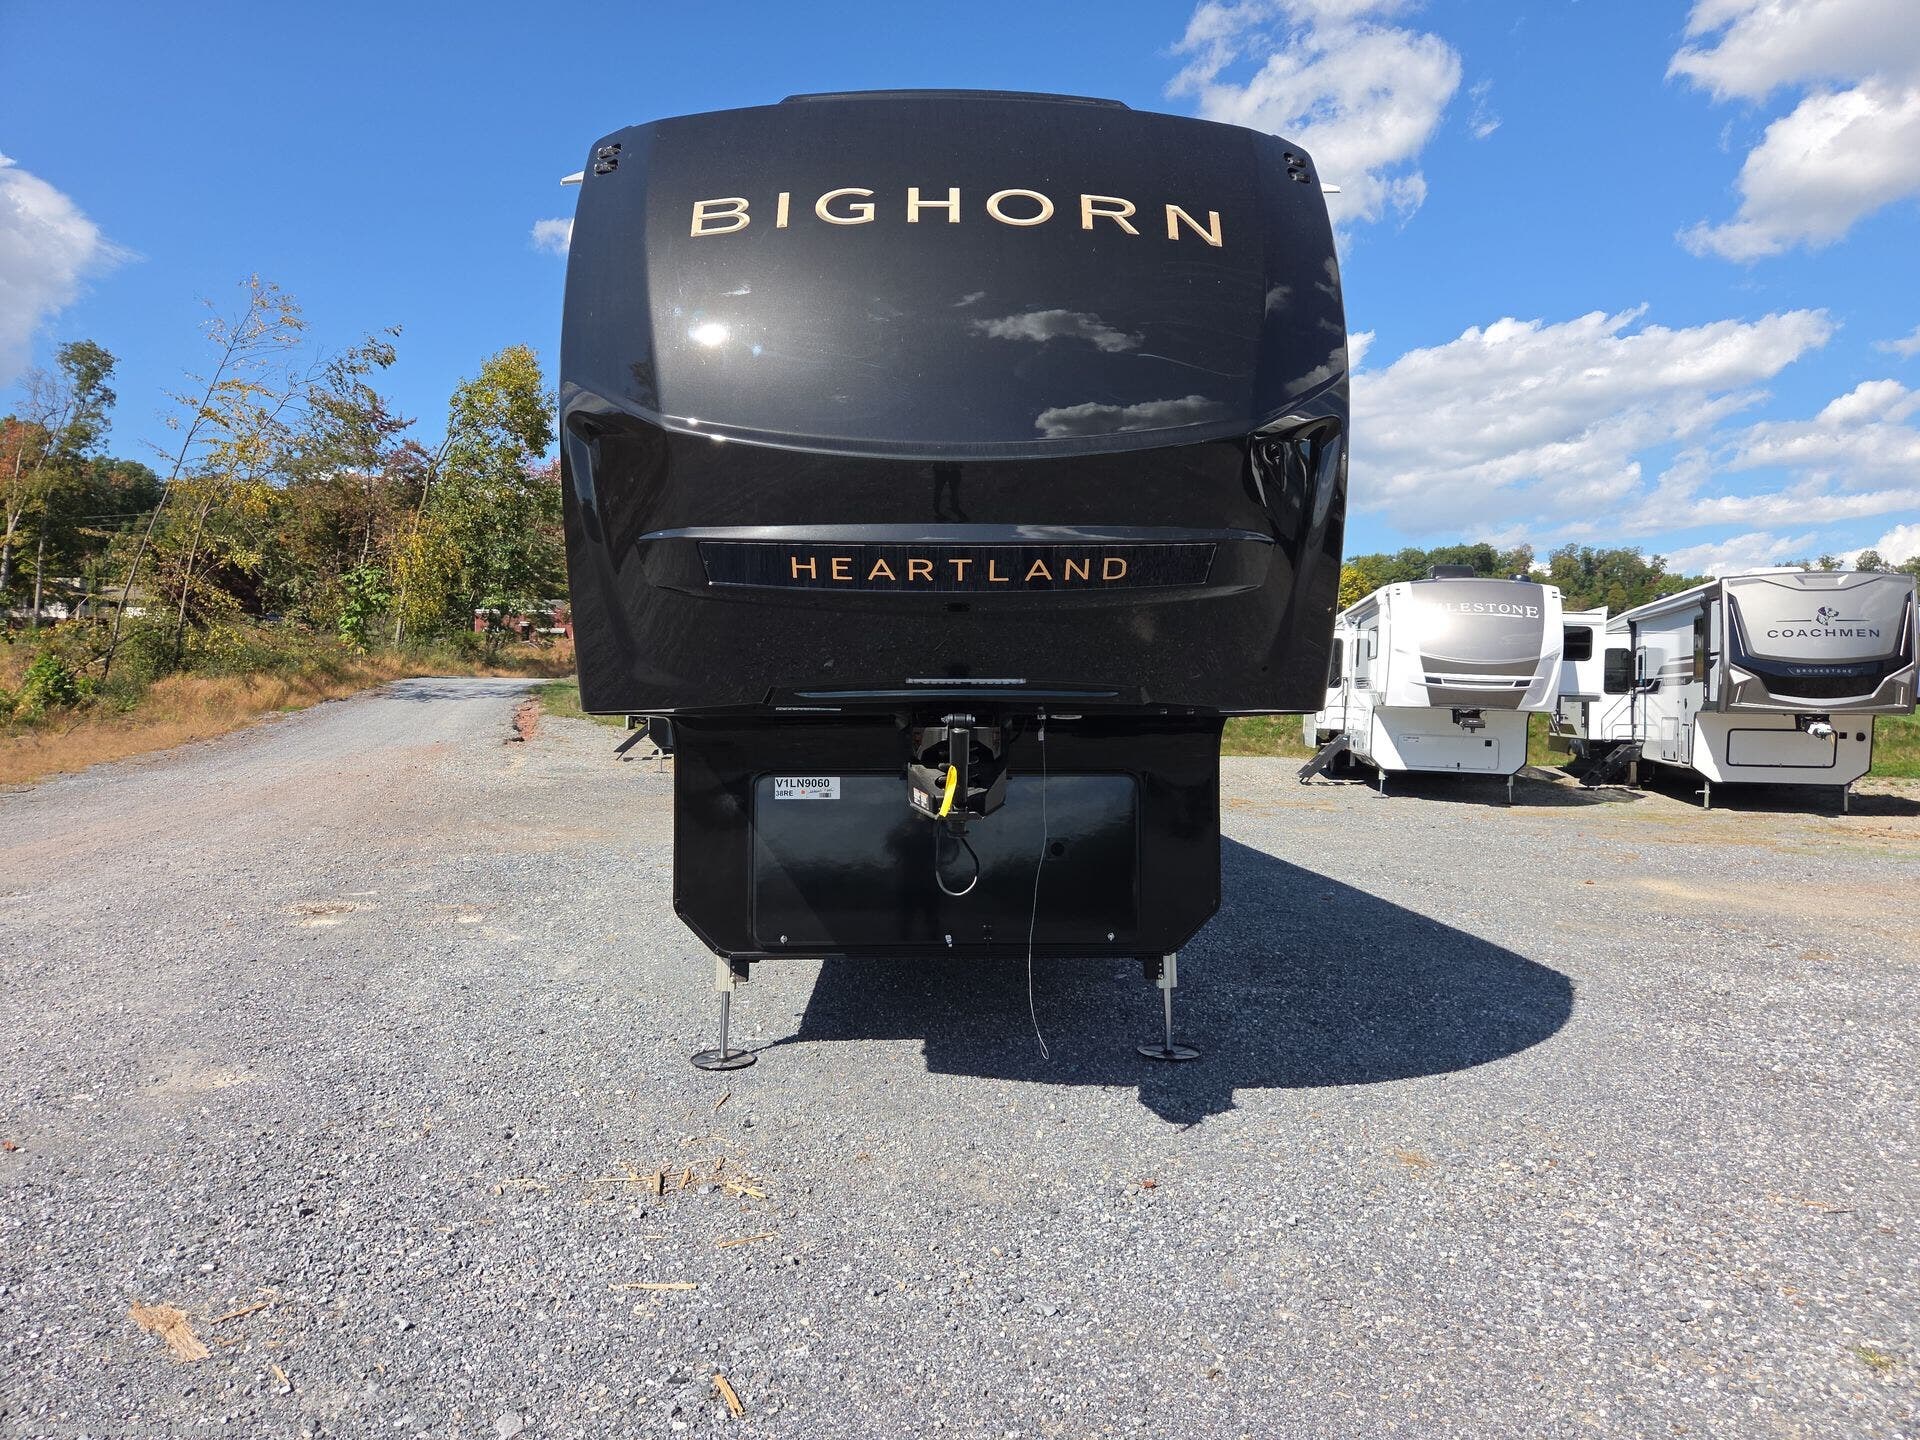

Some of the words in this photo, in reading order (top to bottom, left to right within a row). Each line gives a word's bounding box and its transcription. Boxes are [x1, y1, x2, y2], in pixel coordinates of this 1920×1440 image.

[690, 187, 1222, 247] BIGHORN
[791, 556, 1127, 582] HEARTLAND
[1425, 601, 1539, 618] LESTONE
[1767, 629, 1880, 638] COACHMEN
[776, 778, 830, 788] V1LN9060
